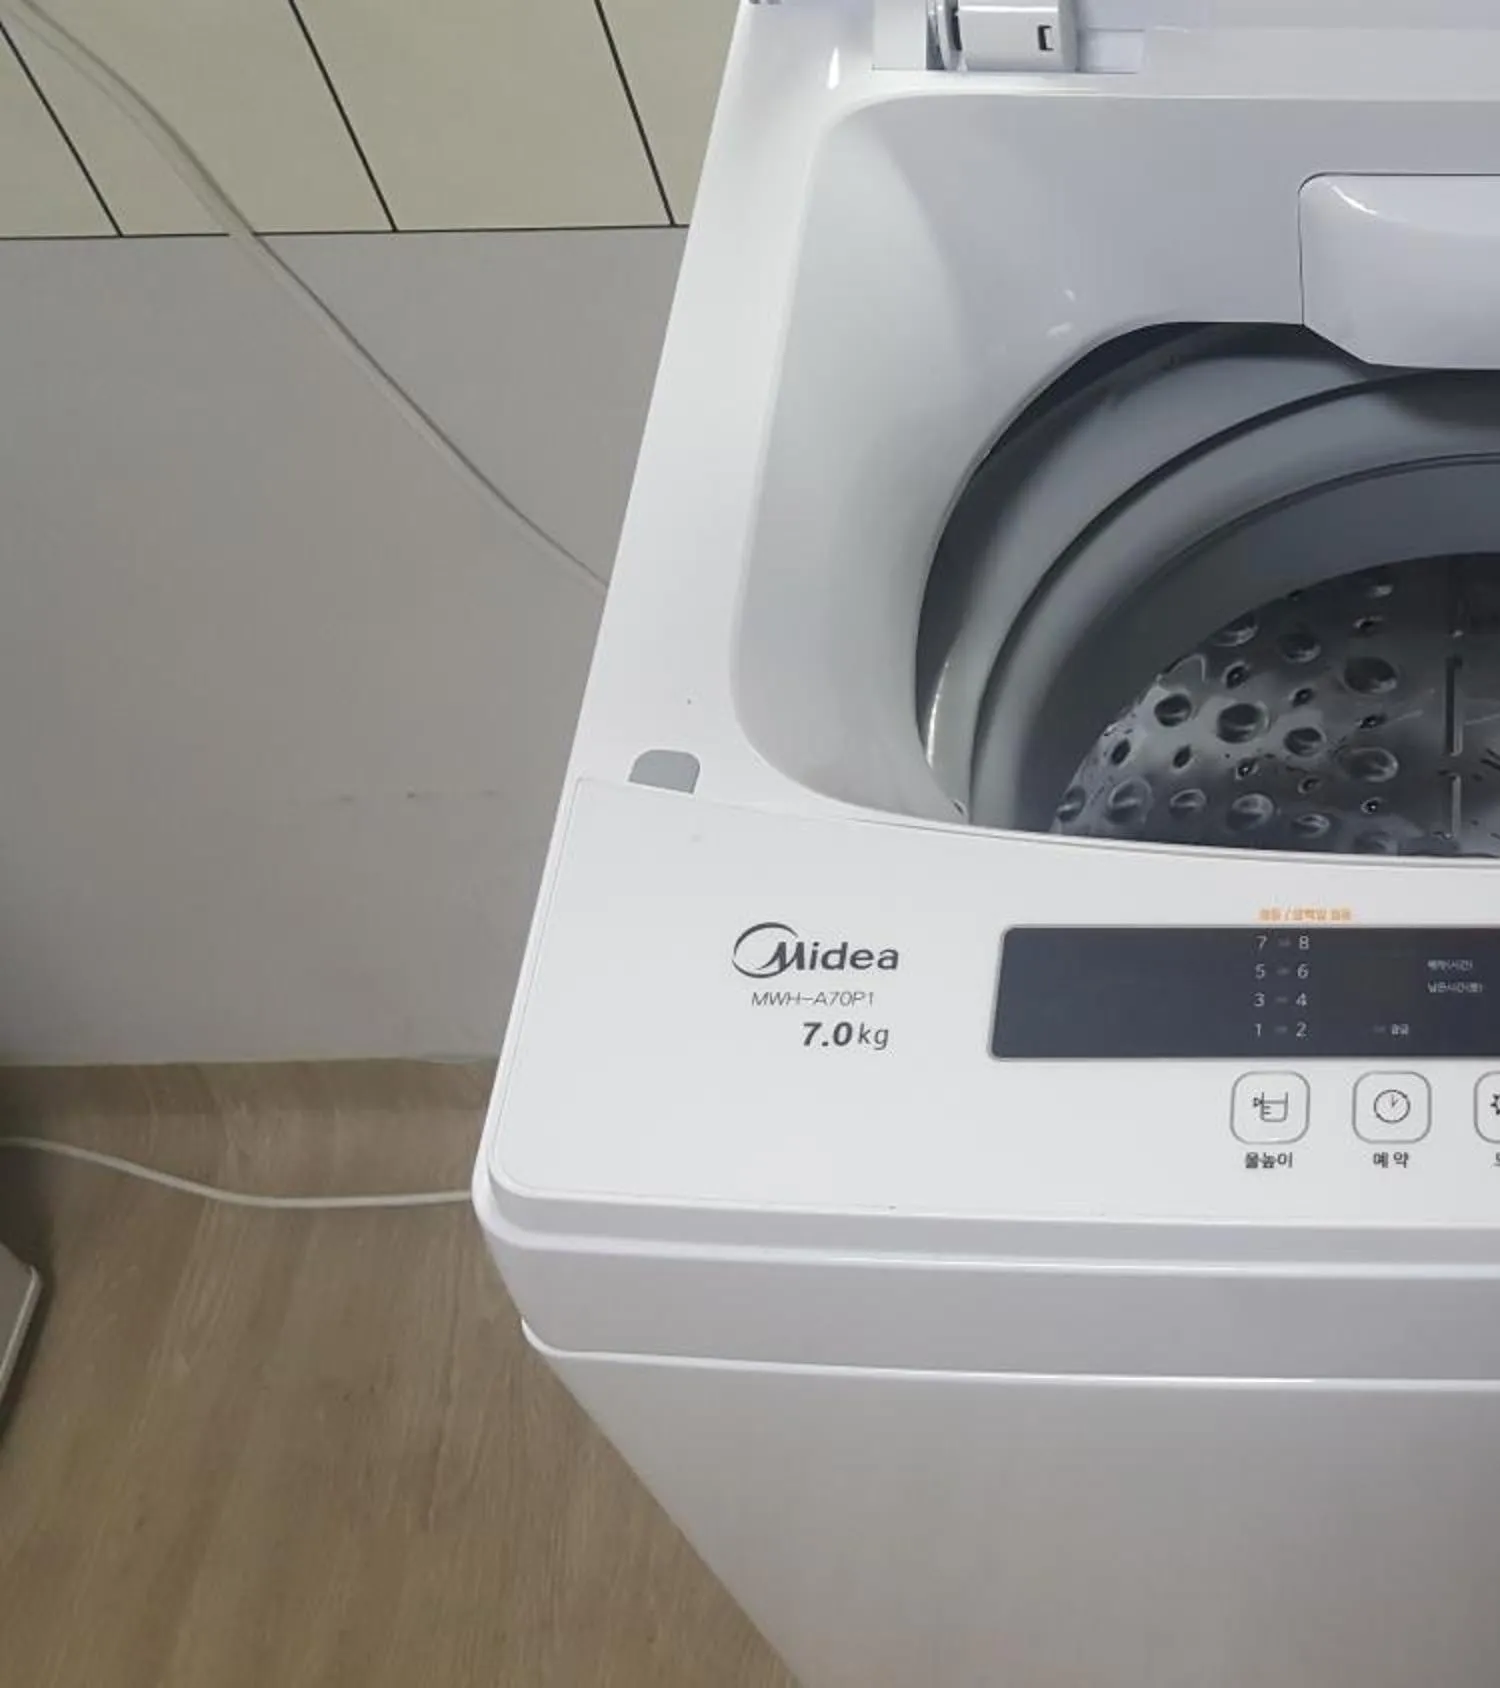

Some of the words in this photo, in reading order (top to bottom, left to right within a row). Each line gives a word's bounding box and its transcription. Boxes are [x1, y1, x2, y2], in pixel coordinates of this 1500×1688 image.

[732, 922, 899, 979] Midea
[1257, 936, 1267, 950] 7
[1299, 936, 1310, 950] 8
[1255, 964, 1266, 979] 5
[1297, 964, 1309, 979] 6
[752, 991, 874, 1007] MWH-A70P1
[1254, 993, 1265, 1007] 3
[1296, 993, 1307, 1007] 4
[1255, 1023, 1262, 1037] 1
[1296, 1023, 1307, 1037] 2
[1245, 1152, 1293, 1169] 물높이
